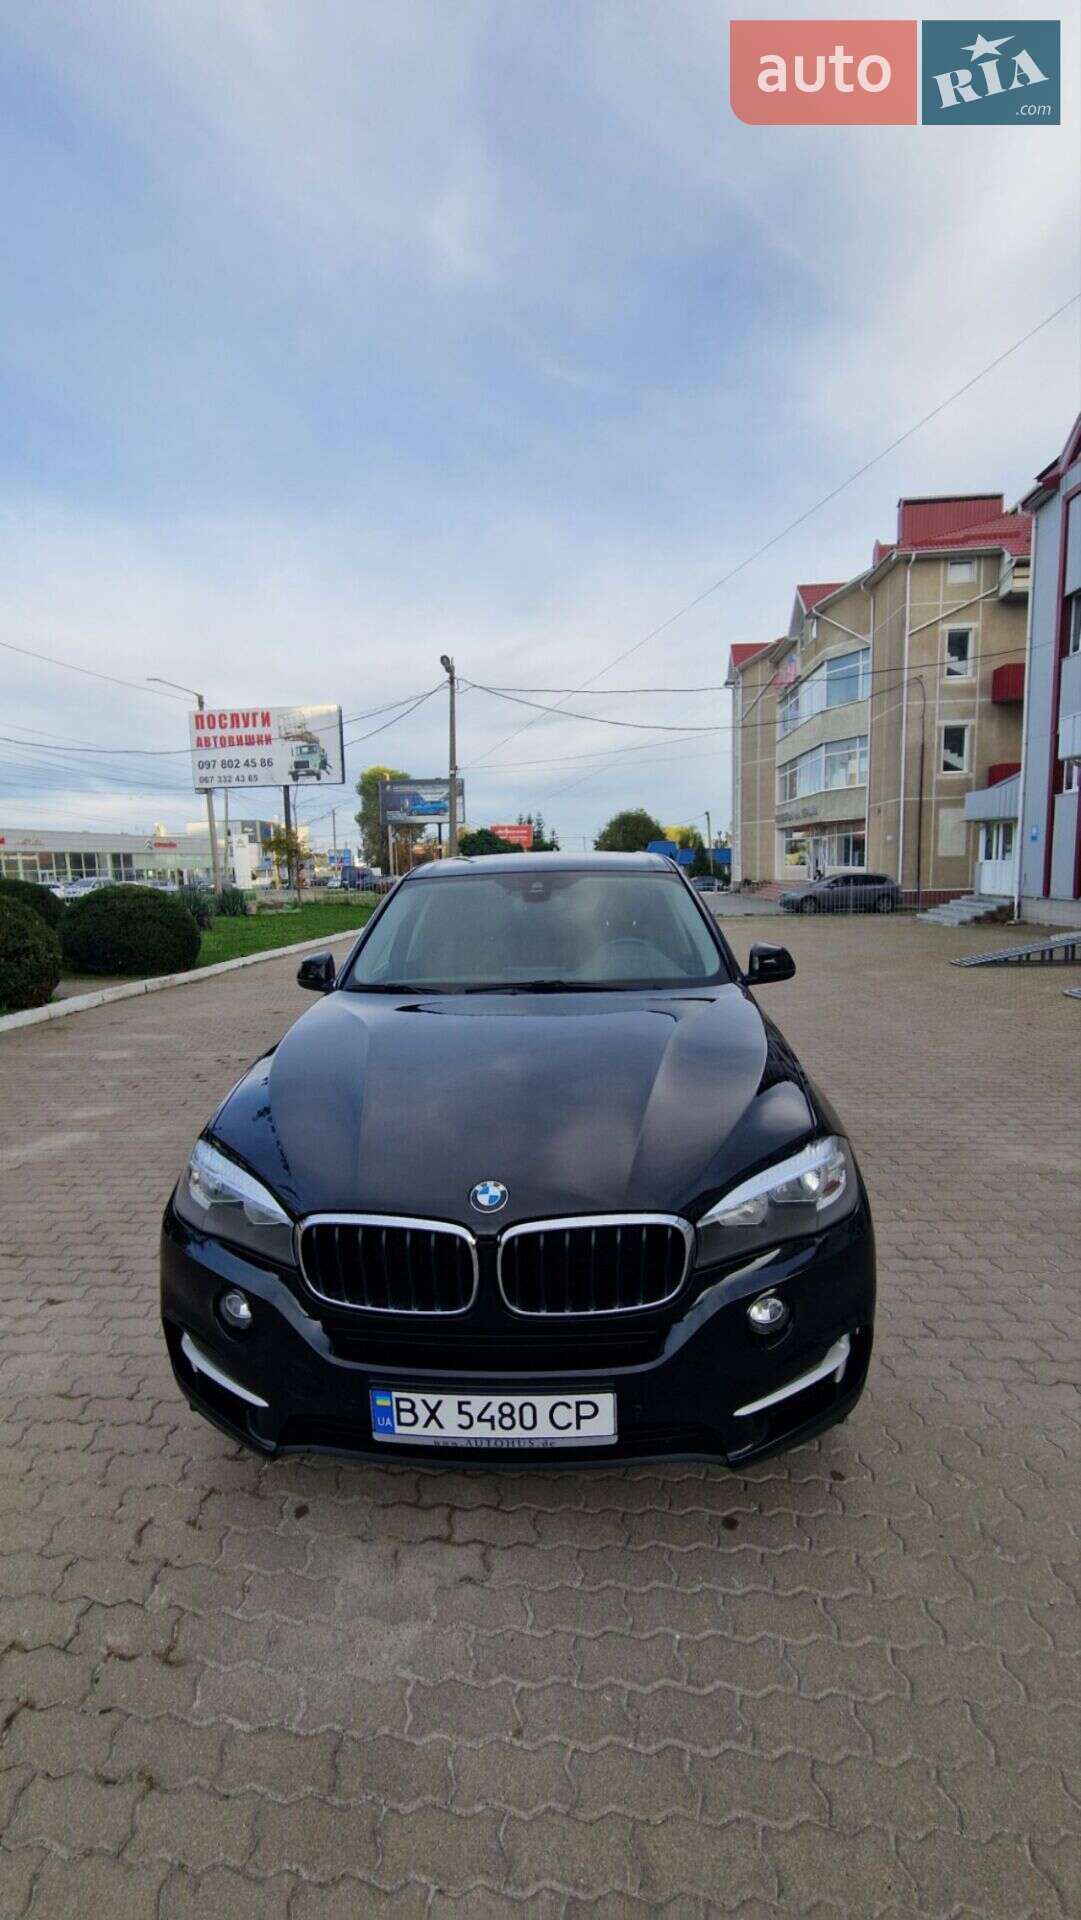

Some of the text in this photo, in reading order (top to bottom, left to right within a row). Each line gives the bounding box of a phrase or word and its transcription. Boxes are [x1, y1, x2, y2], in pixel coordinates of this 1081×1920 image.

[195, 711, 271, 730] ПОСЛУГИ
[196, 733, 272, 748] АВТОВИШКИ
[198, 757, 274, 770] 097 802 45 86
[377, 1416, 393, 1427] UA
[395, 1397, 600, 1431] BX 5480 CP
